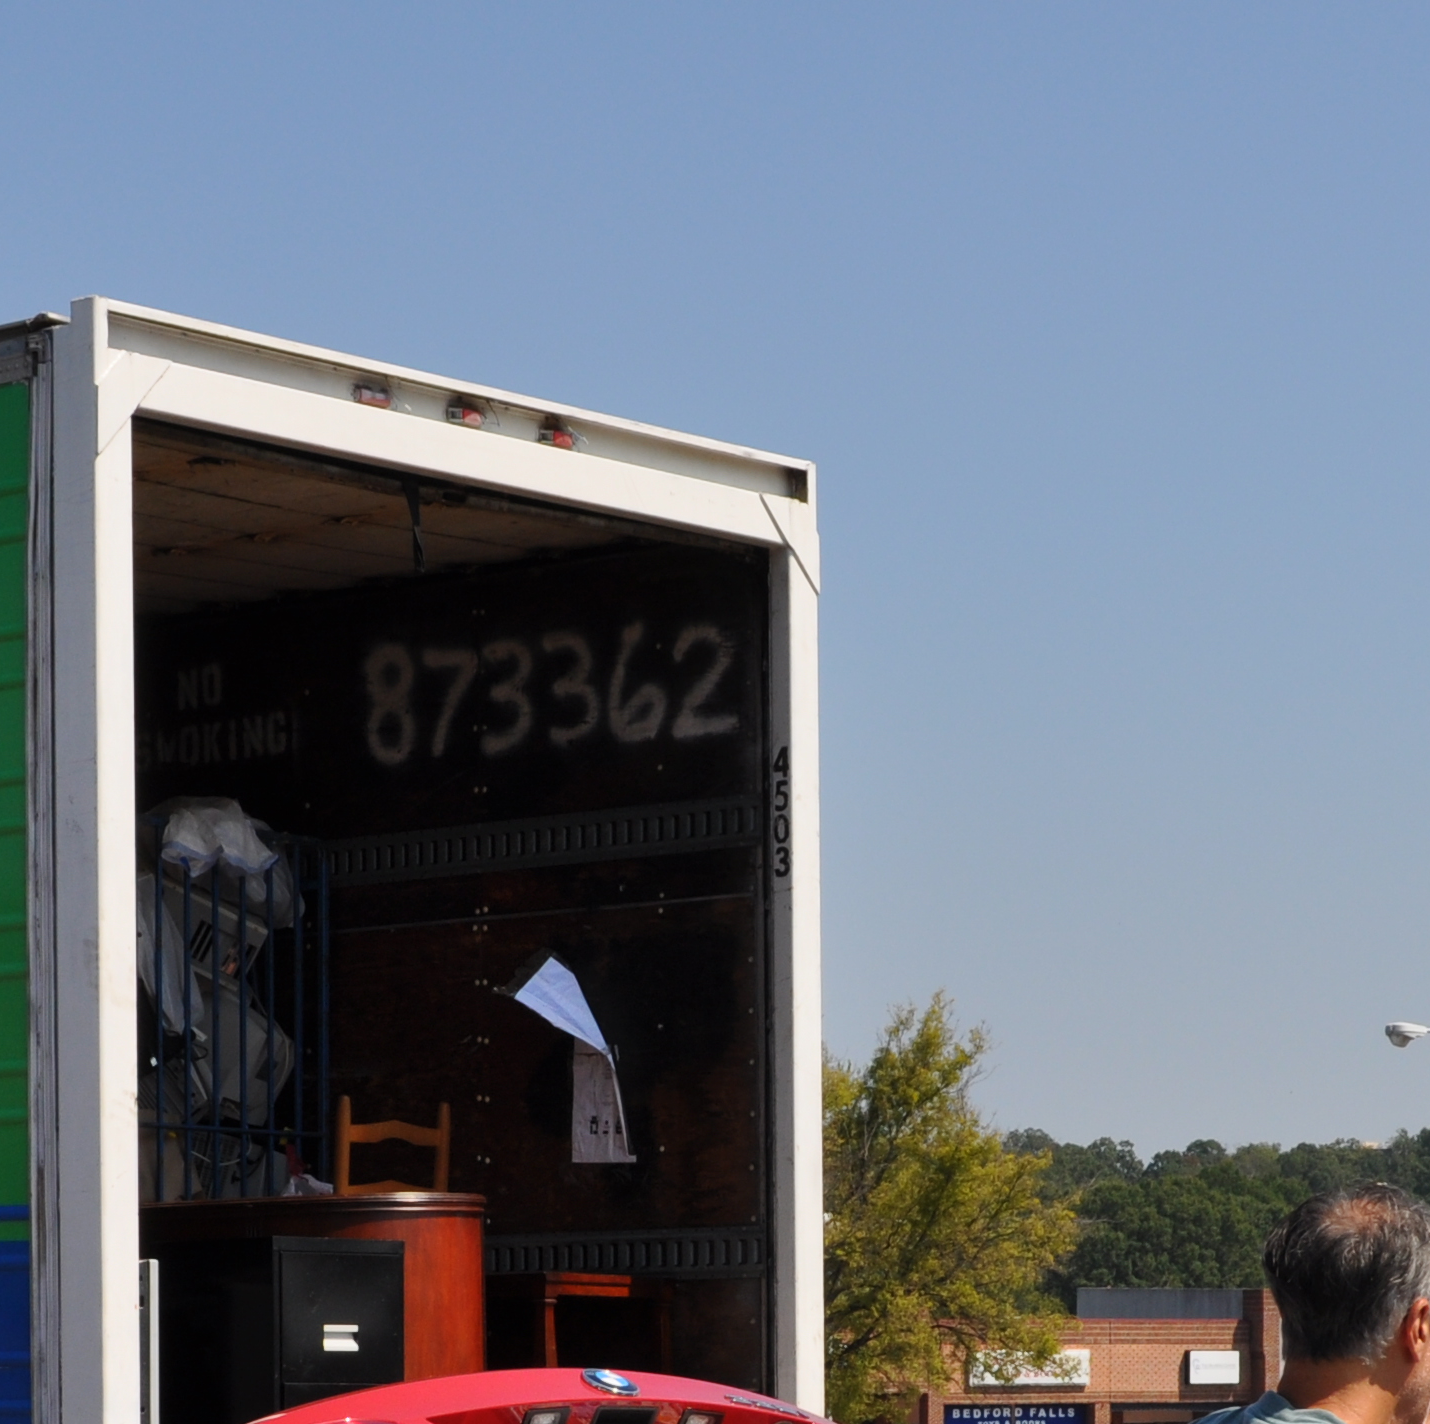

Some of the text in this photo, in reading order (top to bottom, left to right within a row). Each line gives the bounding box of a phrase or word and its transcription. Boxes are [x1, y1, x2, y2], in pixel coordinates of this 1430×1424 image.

[176, 663, 223, 711] NO
[364, 622, 740, 767] 873362
[773, 746, 791, 878] 4503
[952, 1407, 1076, 1419] BEDFORD FALLS
